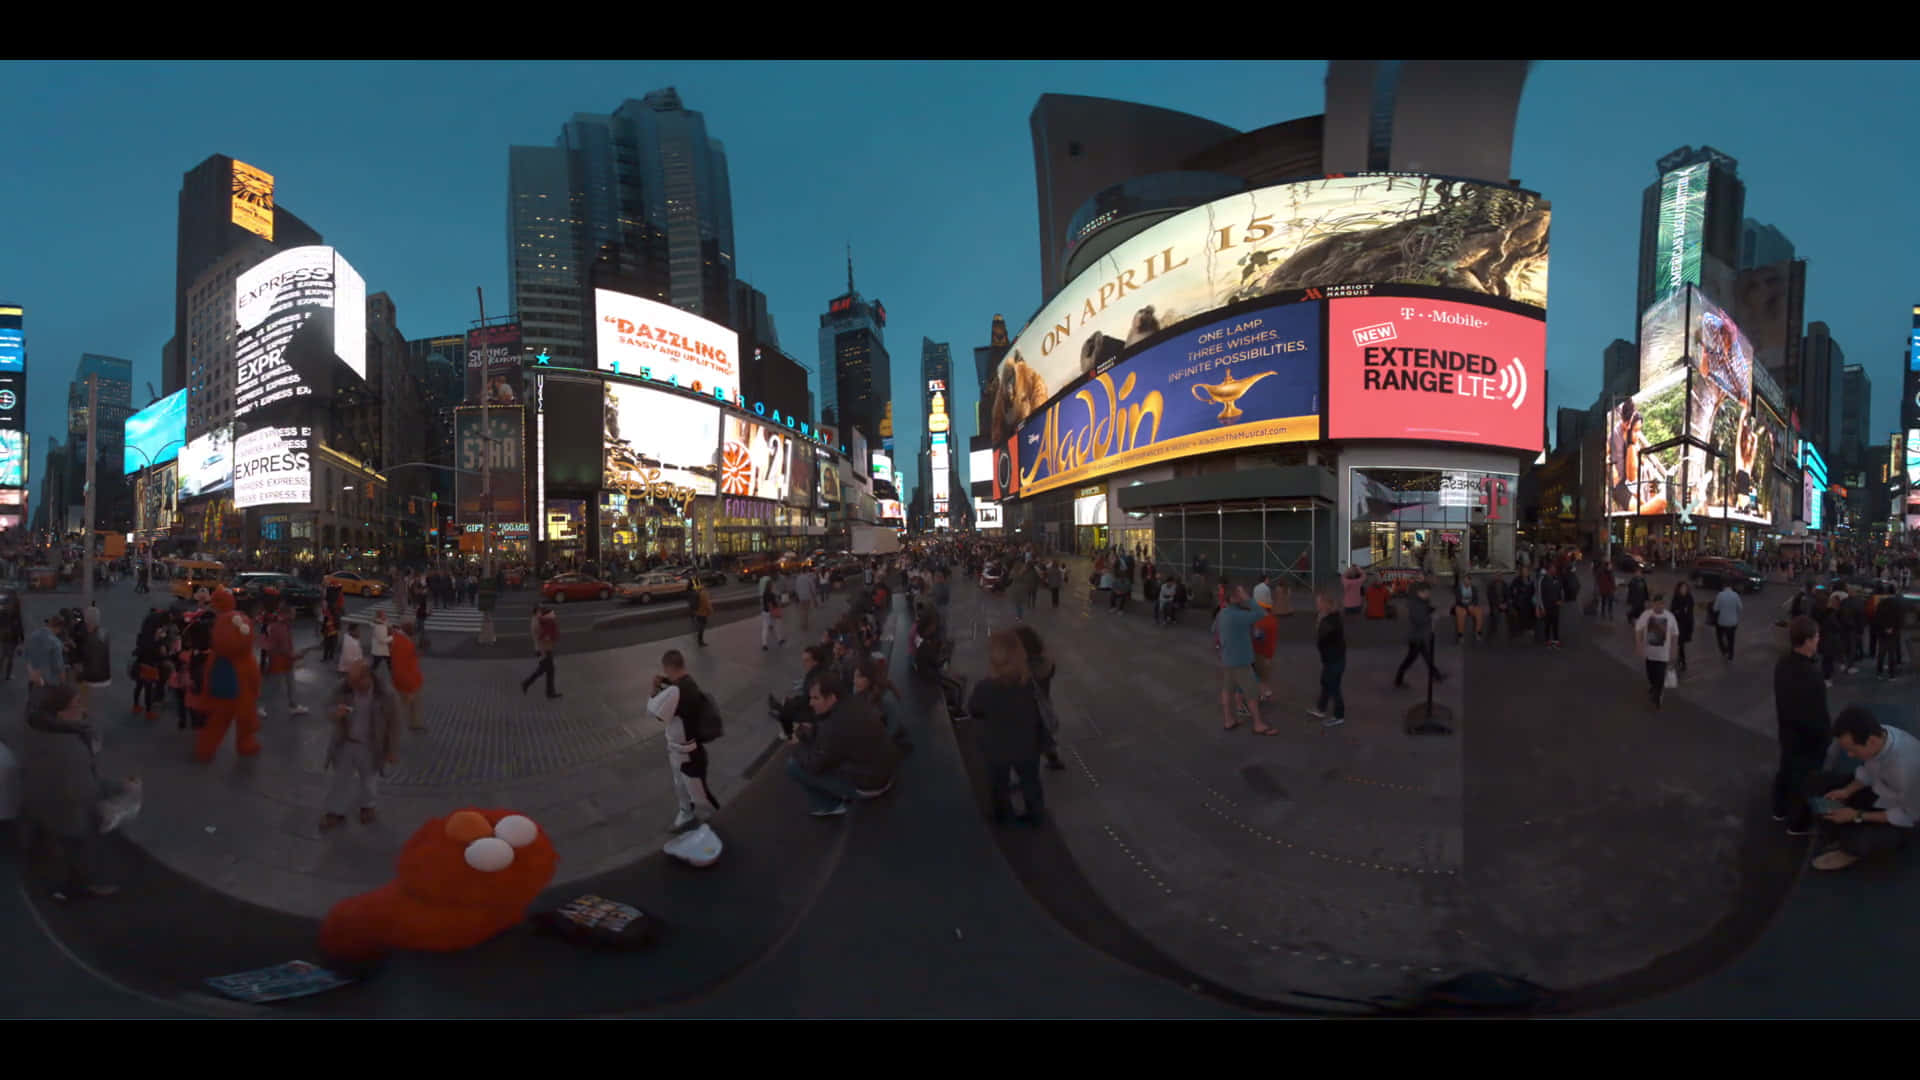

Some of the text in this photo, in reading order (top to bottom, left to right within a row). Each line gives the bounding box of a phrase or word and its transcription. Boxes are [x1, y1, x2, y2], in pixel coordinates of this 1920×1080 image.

[1670, 238, 1684, 287] AMERICAN
[239, 267, 329, 309] EXPRESS
[1040, 214, 1275, 357] ON APRIL 15
[1326, 284, 1374, 292] MARRIOTT
[618, 336, 658, 351] SASSY
[659, 345, 681, 358] AND
[1187, 329, 1280, 361] THREE WISHES.
[1198, 319, 1264, 345] ONE LAMP.
[1356, 326, 1392, 344] NEW
[1168, 340, 1308, 383] INFINITE POSSIBILITIES.
[1364, 347, 1498, 376] EXTENDED
[1364, 369, 1497, 400] RANGE LTE
[609, 361, 832, 446] 1540 BROADWAY
[1020, 372, 1164, 487] Aladdin
[235, 452, 311, 480] EXPRESS
[465, 523, 484, 533] GIFT
